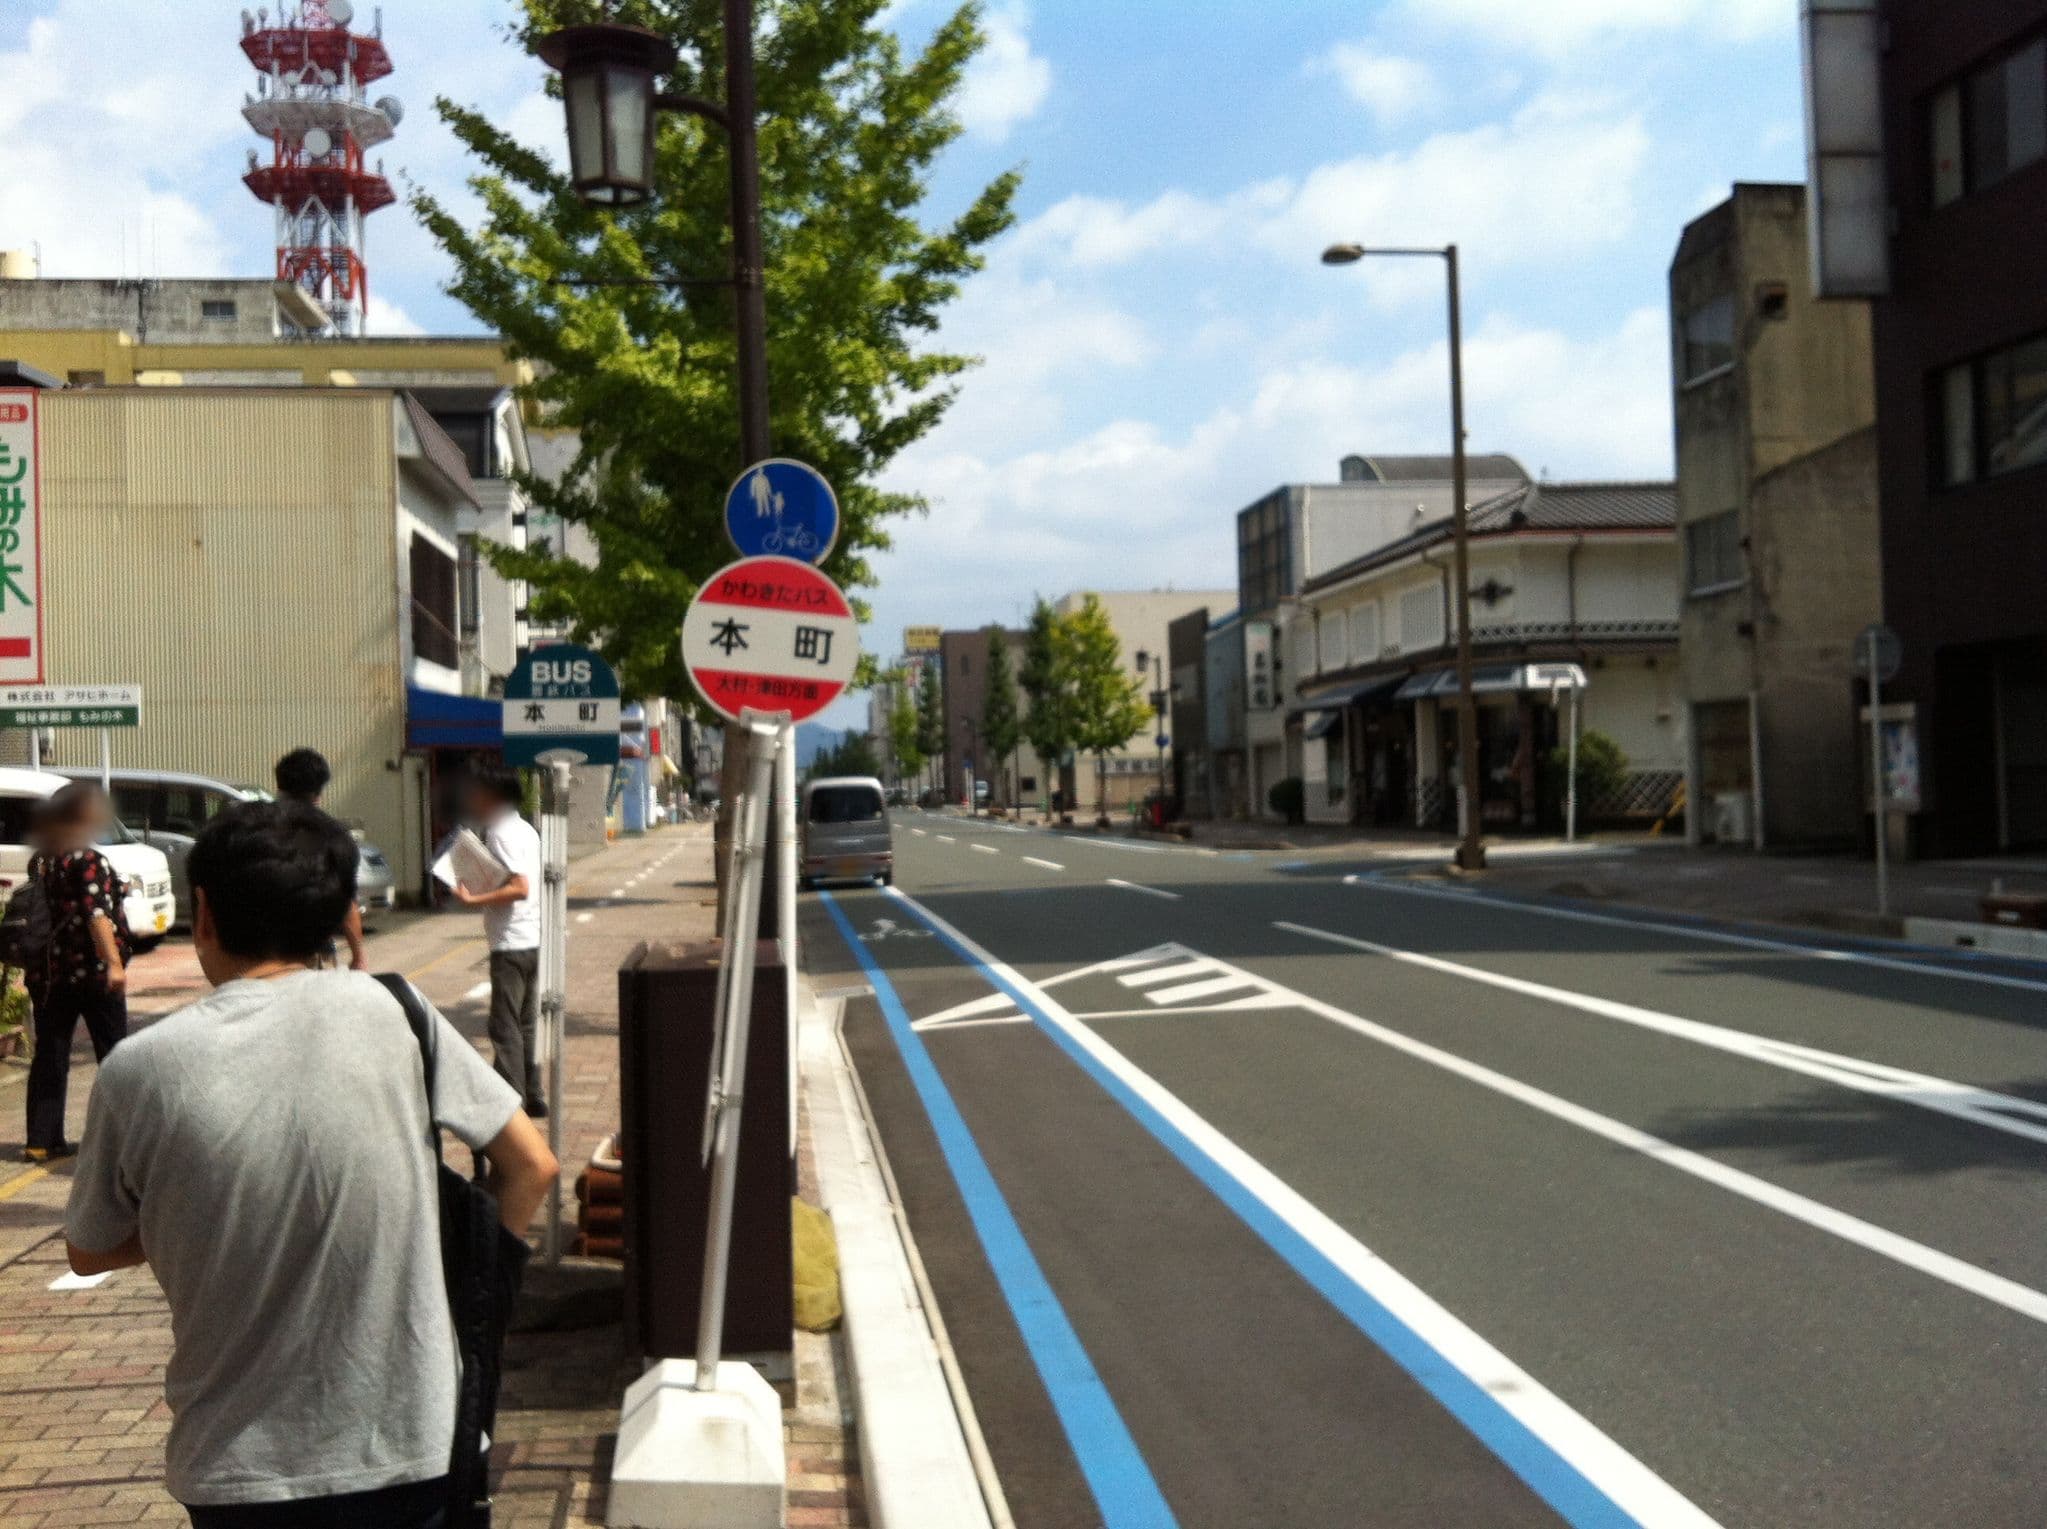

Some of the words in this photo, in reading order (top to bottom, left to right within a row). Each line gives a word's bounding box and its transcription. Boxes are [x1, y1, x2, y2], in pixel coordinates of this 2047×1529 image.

[723, 580, 828, 604] かわきたバス
[710, 618, 834, 665] 本町
[532, 660, 592, 684] BUS
[79, 711, 122, 723] もみの木
[524, 702, 599, 722] 本町
